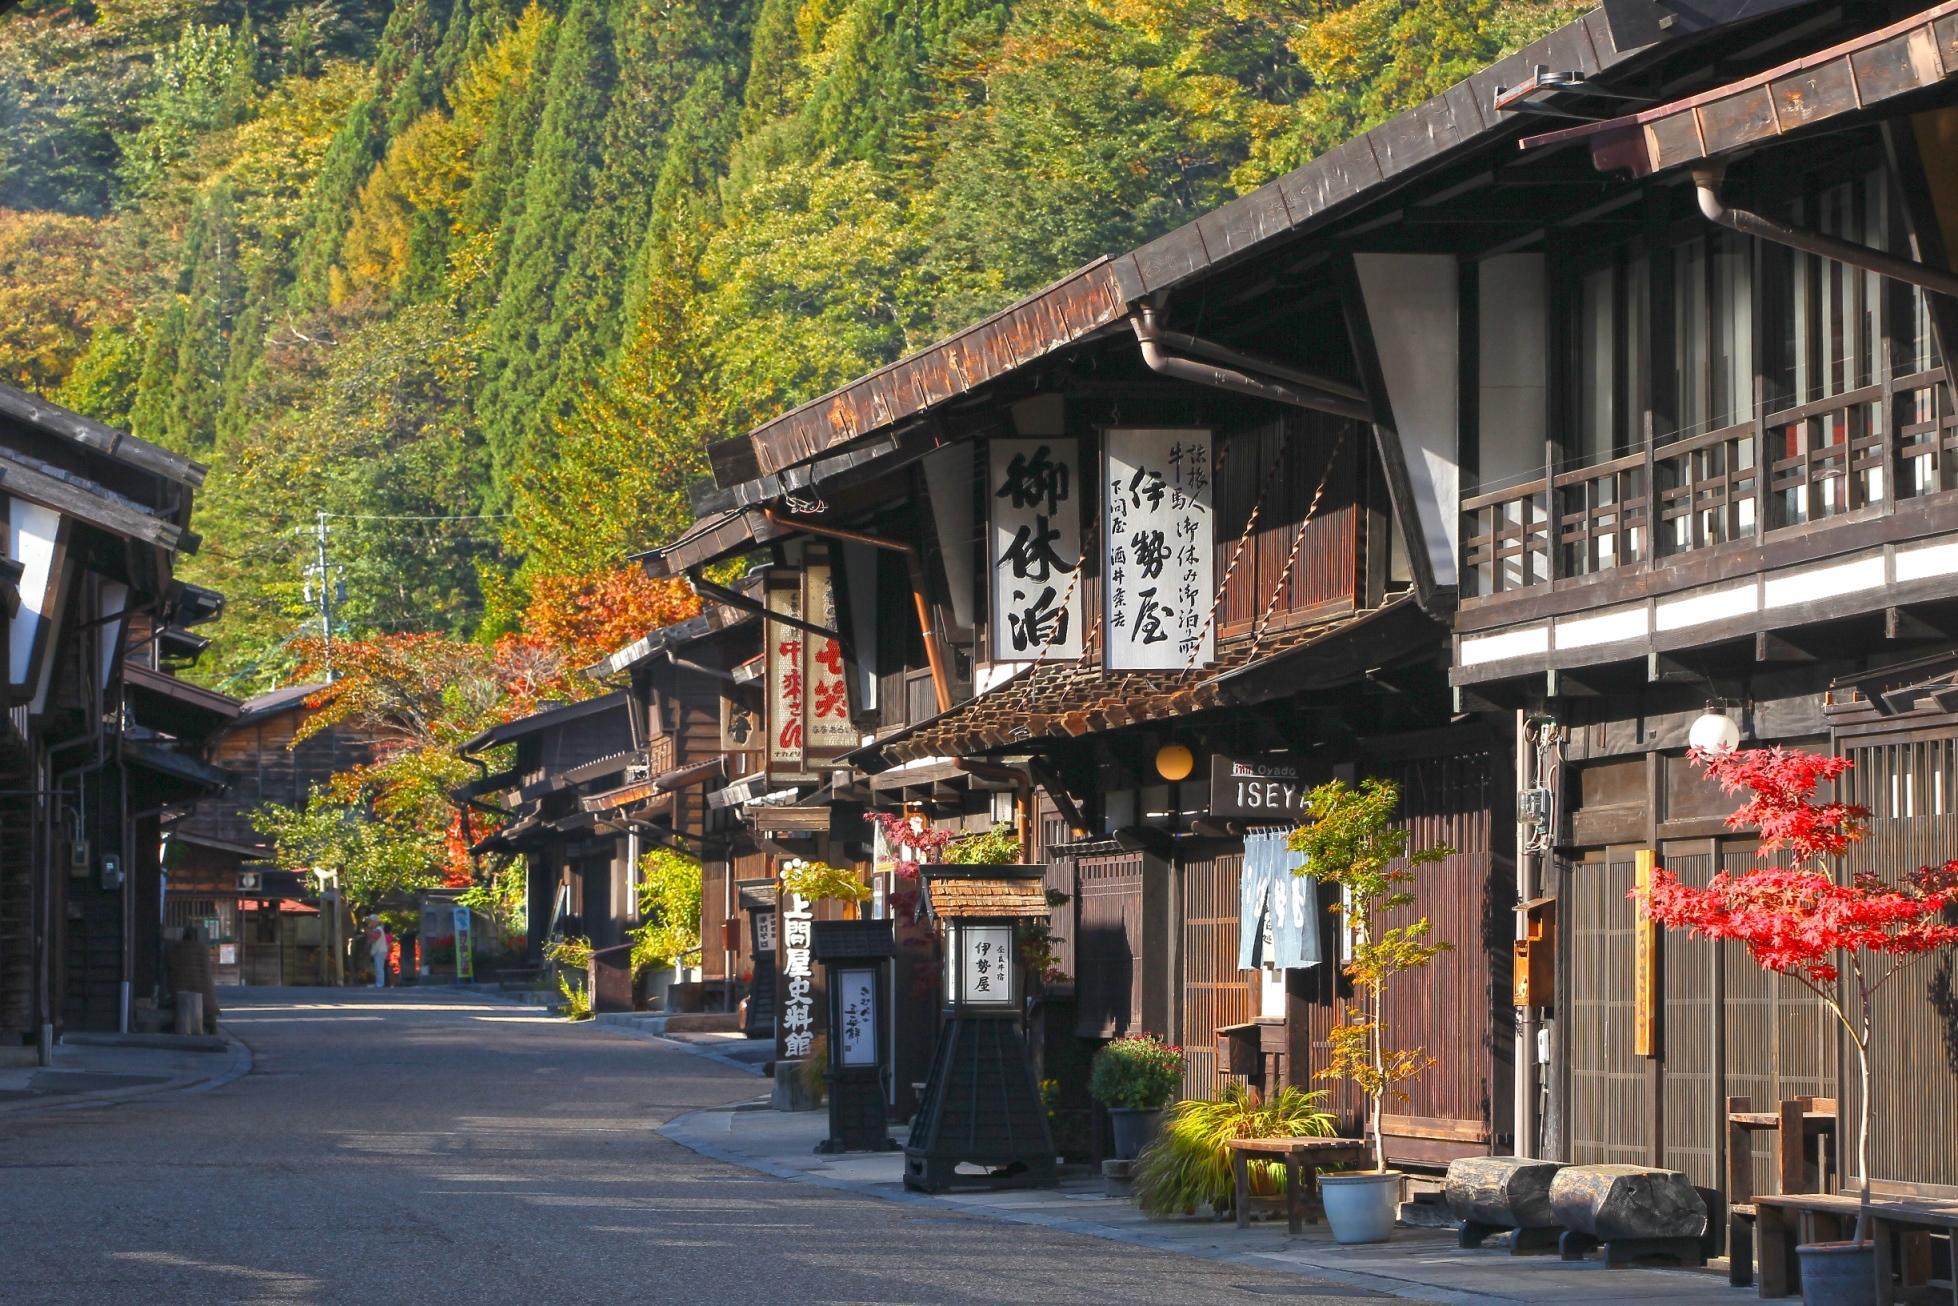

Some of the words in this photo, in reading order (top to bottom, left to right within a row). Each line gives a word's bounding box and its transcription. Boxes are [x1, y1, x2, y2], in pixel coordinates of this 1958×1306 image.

[995, 445, 1076, 652] 御休泊
[1129, 465, 1174, 645] 伊勢屋
[815, 638, 848, 719] 七笑
[1257, 764, 1297, 777] Oyado
[783, 893, 814, 1058] 上問屋史料館
[974, 941, 992, 993] 伊勢屋
